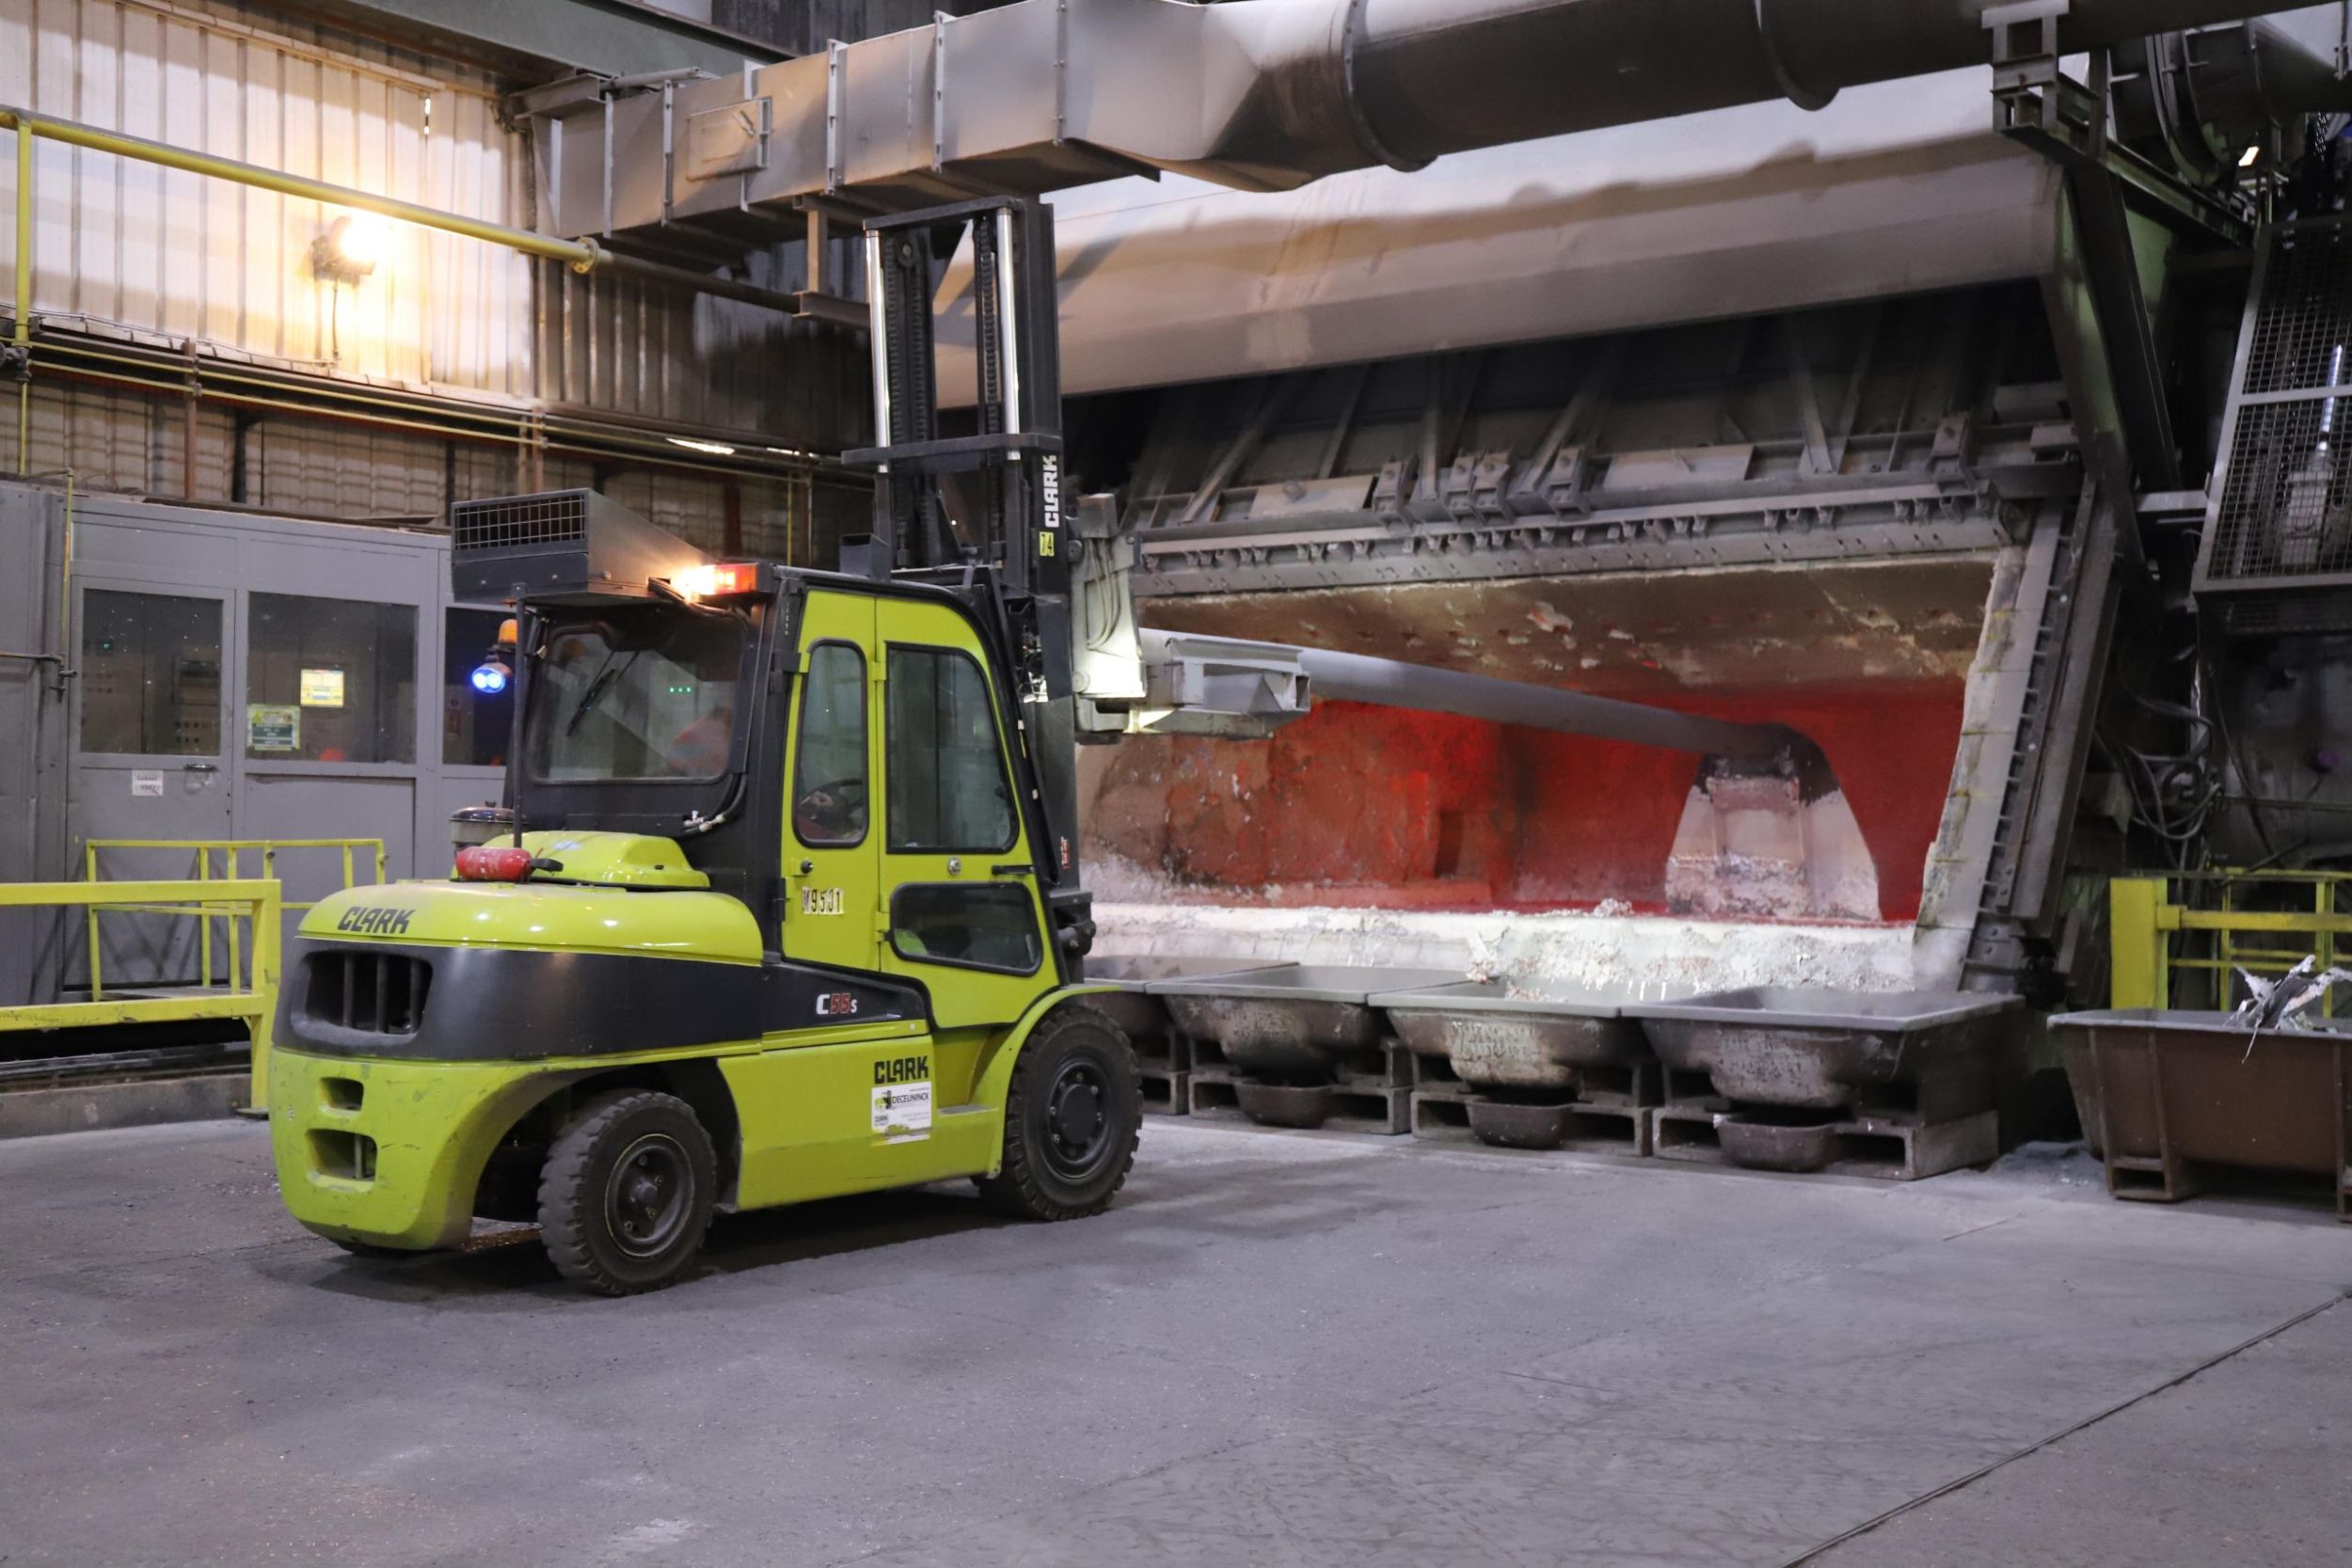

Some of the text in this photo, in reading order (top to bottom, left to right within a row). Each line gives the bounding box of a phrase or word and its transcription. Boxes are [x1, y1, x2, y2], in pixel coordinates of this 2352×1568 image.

[1042, 455, 1059, 528] CLARK
[338, 907, 416, 934] CLARK
[816, 992, 858, 1015] C55s
[874, 1055, 929, 1085] CLARK
